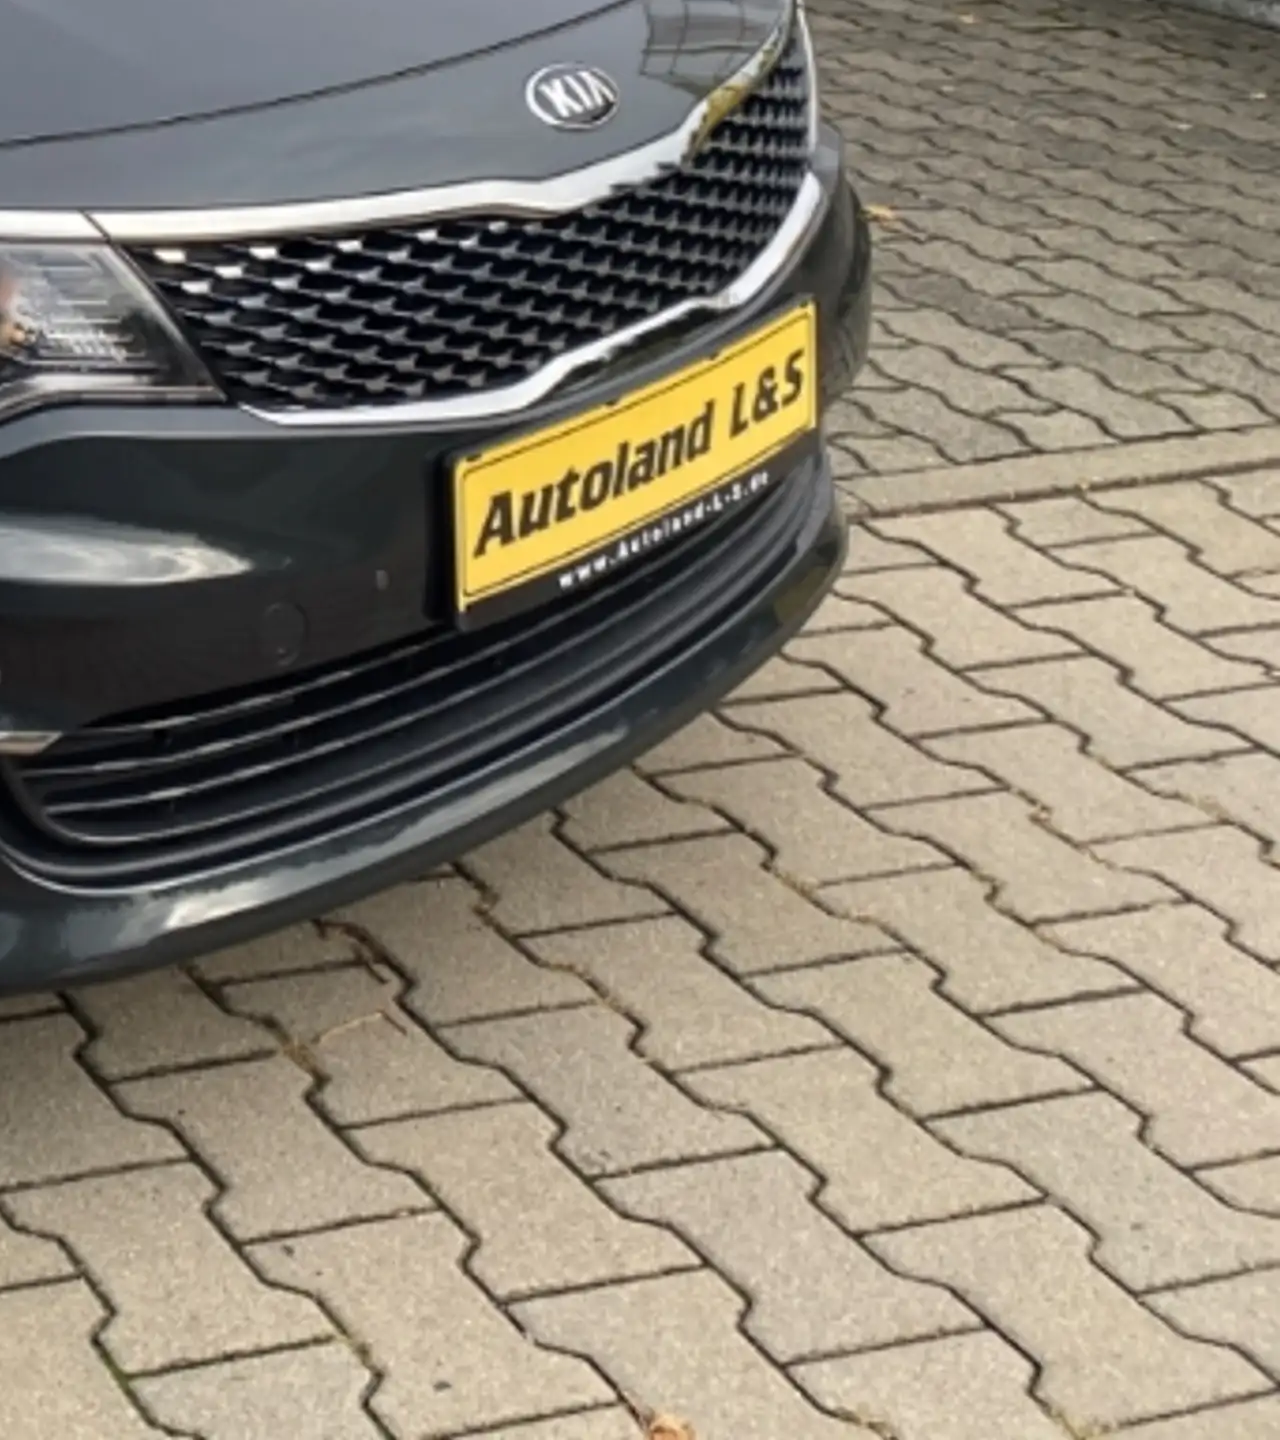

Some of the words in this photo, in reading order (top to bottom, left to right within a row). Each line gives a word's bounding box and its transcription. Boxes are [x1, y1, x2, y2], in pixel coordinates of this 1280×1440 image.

[538, 71, 615, 118] KIA
[473, 398, 716, 558] Autoland
[728, 348, 806, 440] L&S
